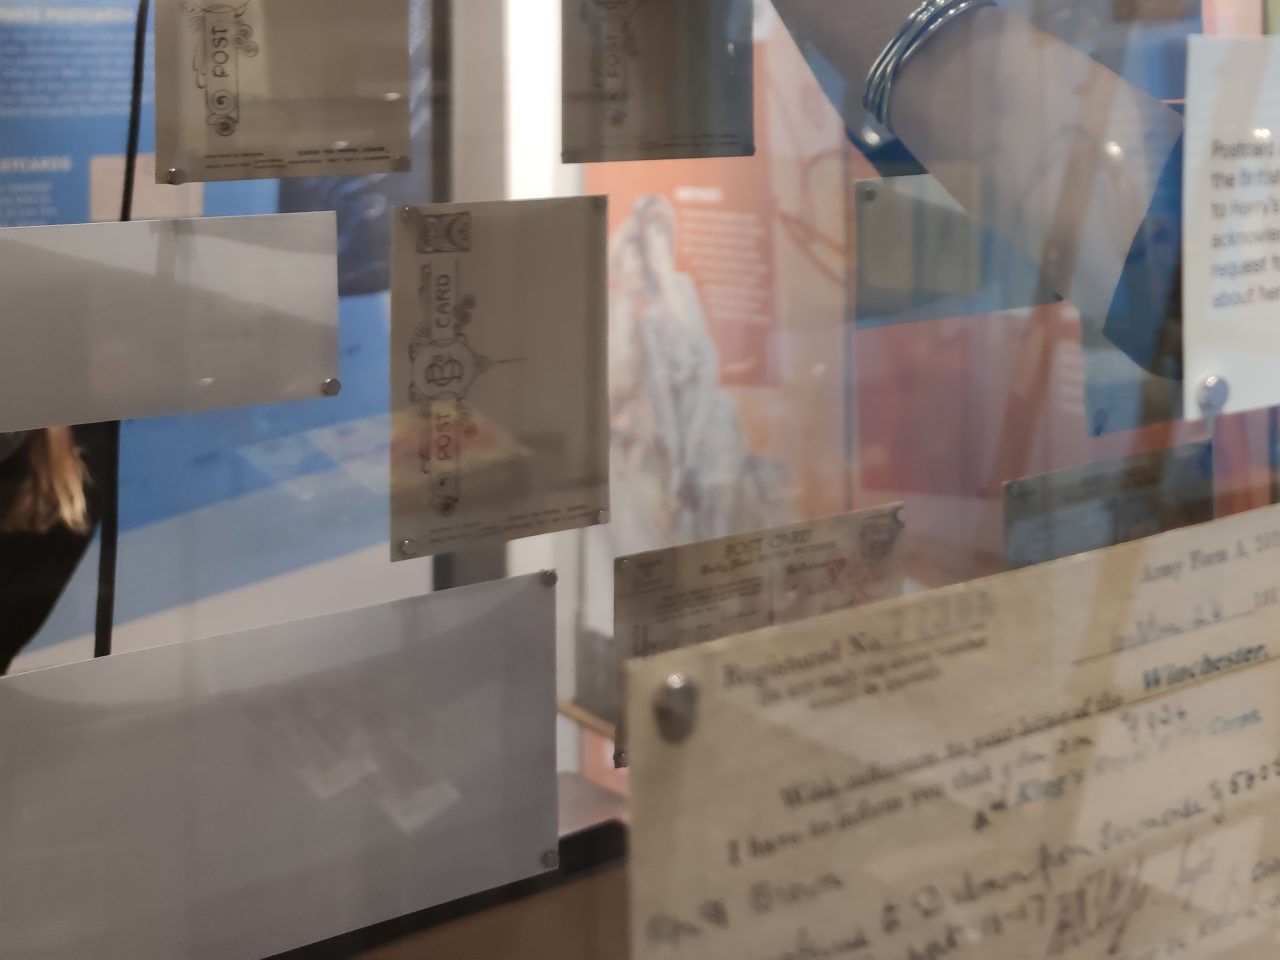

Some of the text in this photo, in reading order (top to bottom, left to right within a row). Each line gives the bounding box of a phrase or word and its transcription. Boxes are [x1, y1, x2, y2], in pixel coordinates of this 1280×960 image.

[211, 24, 230, 79] POST
[435, 271, 453, 329] CARD
[436, 407, 454, 463] POST
